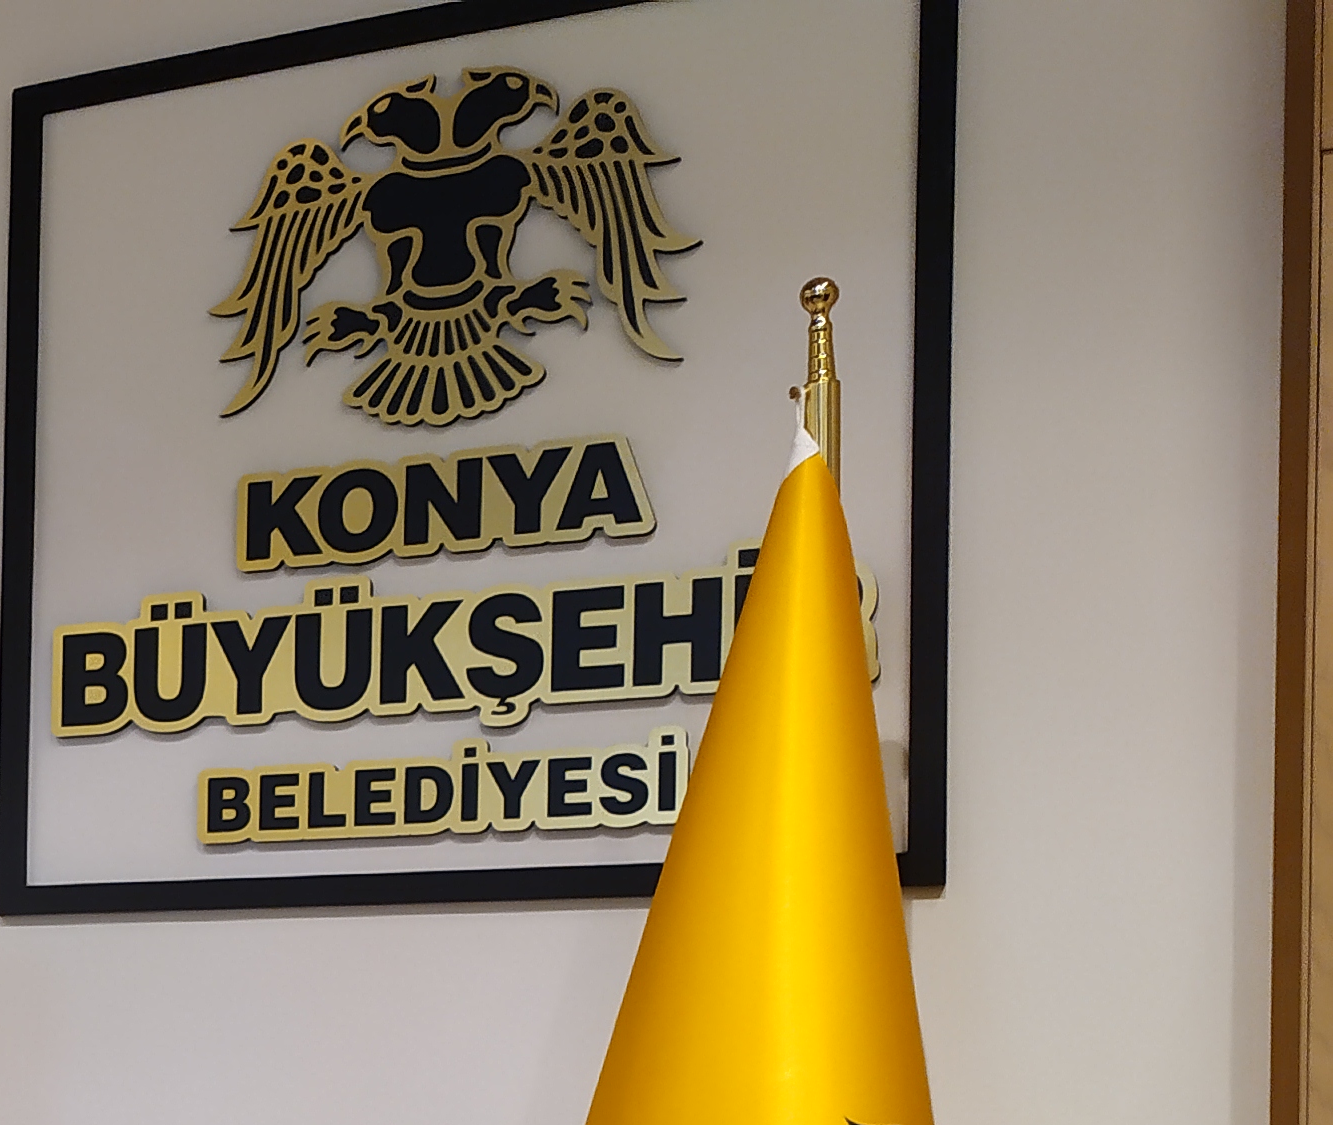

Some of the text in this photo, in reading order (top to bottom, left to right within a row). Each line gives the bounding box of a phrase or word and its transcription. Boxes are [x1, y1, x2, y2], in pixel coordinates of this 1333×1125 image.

[244, 440, 645, 562] KONYA
[59, 547, 864, 728] BÜYÜKŞEH
[205, 733, 679, 834] BELEDİYESİ
